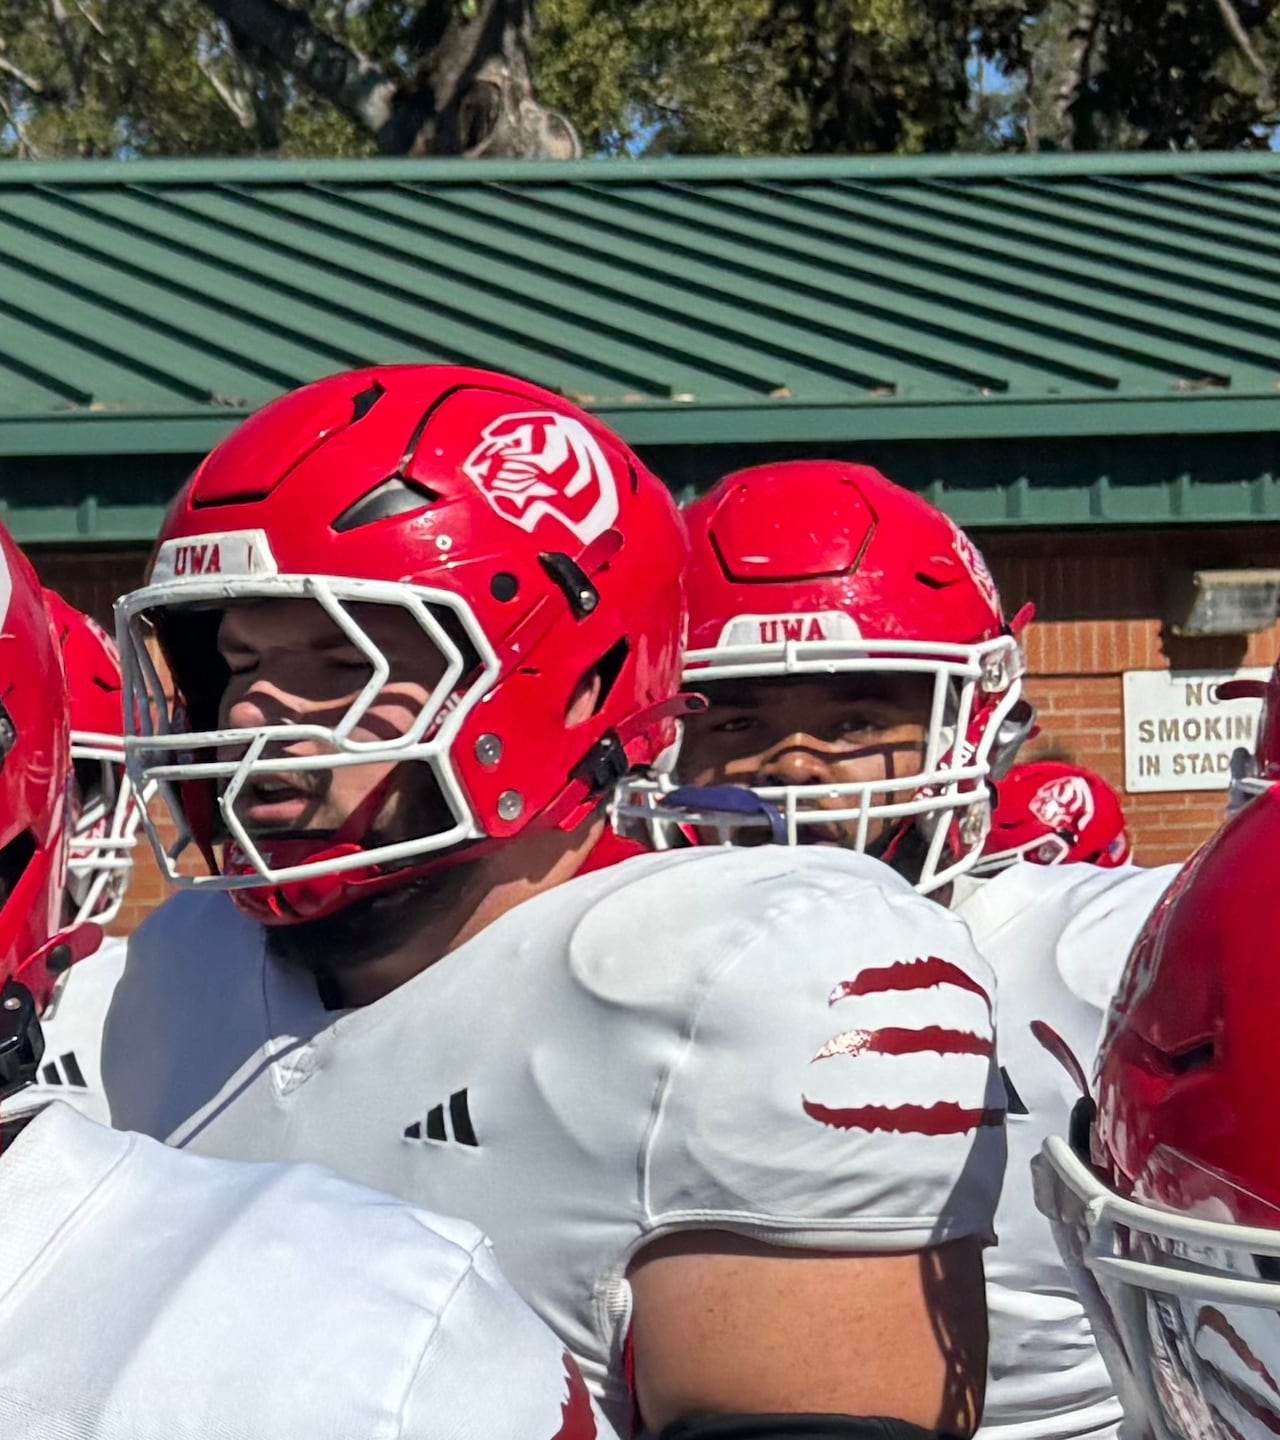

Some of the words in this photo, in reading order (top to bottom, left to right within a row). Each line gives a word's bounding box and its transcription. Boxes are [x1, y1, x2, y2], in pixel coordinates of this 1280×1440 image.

[175, 543, 221, 575] UWA
[759, 617, 826, 644] UWA
[1139, 716, 1252, 743] SMOKIN
[1139, 755, 1160, 776] IN
